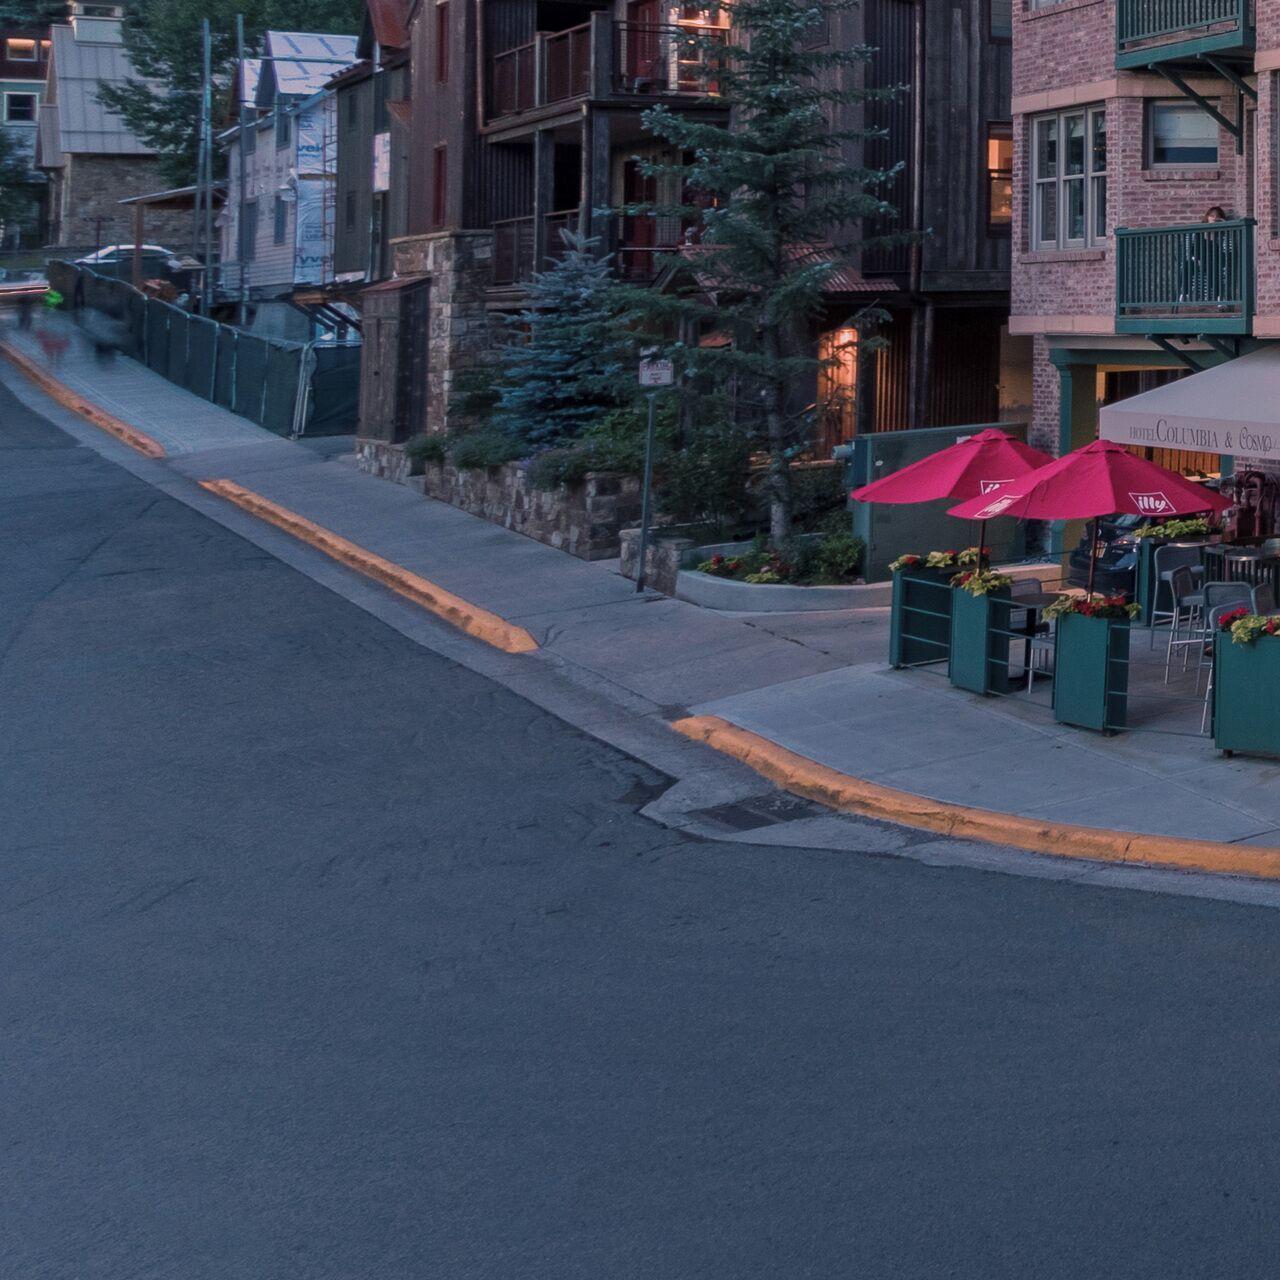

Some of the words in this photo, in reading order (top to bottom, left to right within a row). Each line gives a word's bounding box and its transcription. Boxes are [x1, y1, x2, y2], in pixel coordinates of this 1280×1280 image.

[1129, 426, 1157, 442] HOTEL
[1156, 419, 1219, 448] COLUMBIA
[1224, 431, 1233, 448] &
[1138, 496, 1167, 513] illy
